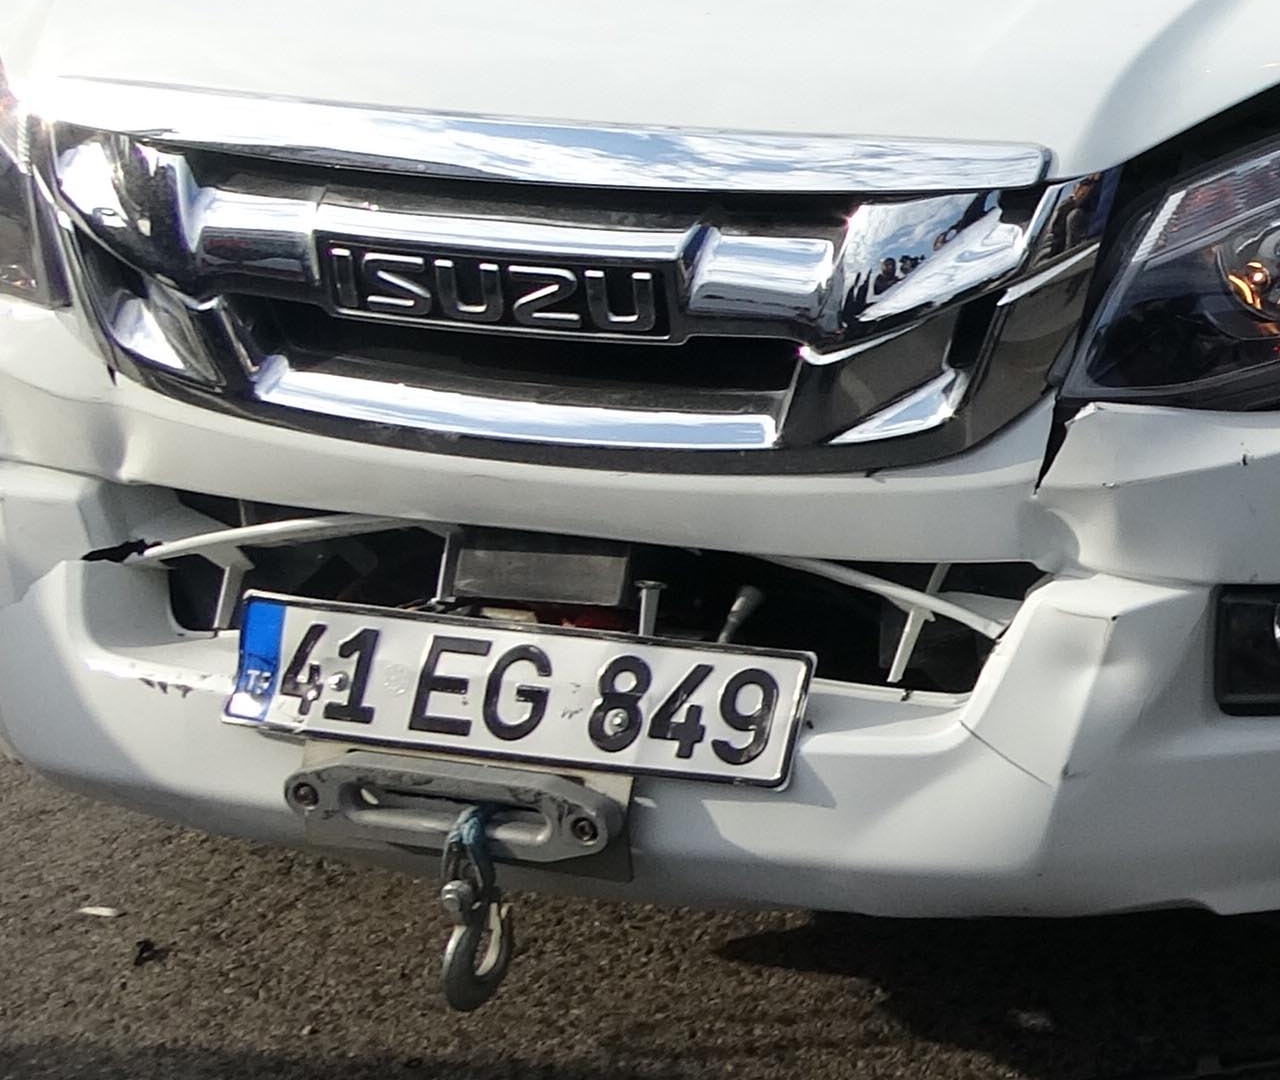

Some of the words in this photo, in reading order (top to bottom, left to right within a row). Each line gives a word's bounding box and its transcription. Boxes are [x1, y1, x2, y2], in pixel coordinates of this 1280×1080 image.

[330, 247, 656, 333] ISUZU
[280, 622, 384, 726] 41
[408, 634, 552, 742] EG
[588, 653, 778, 766] 849
